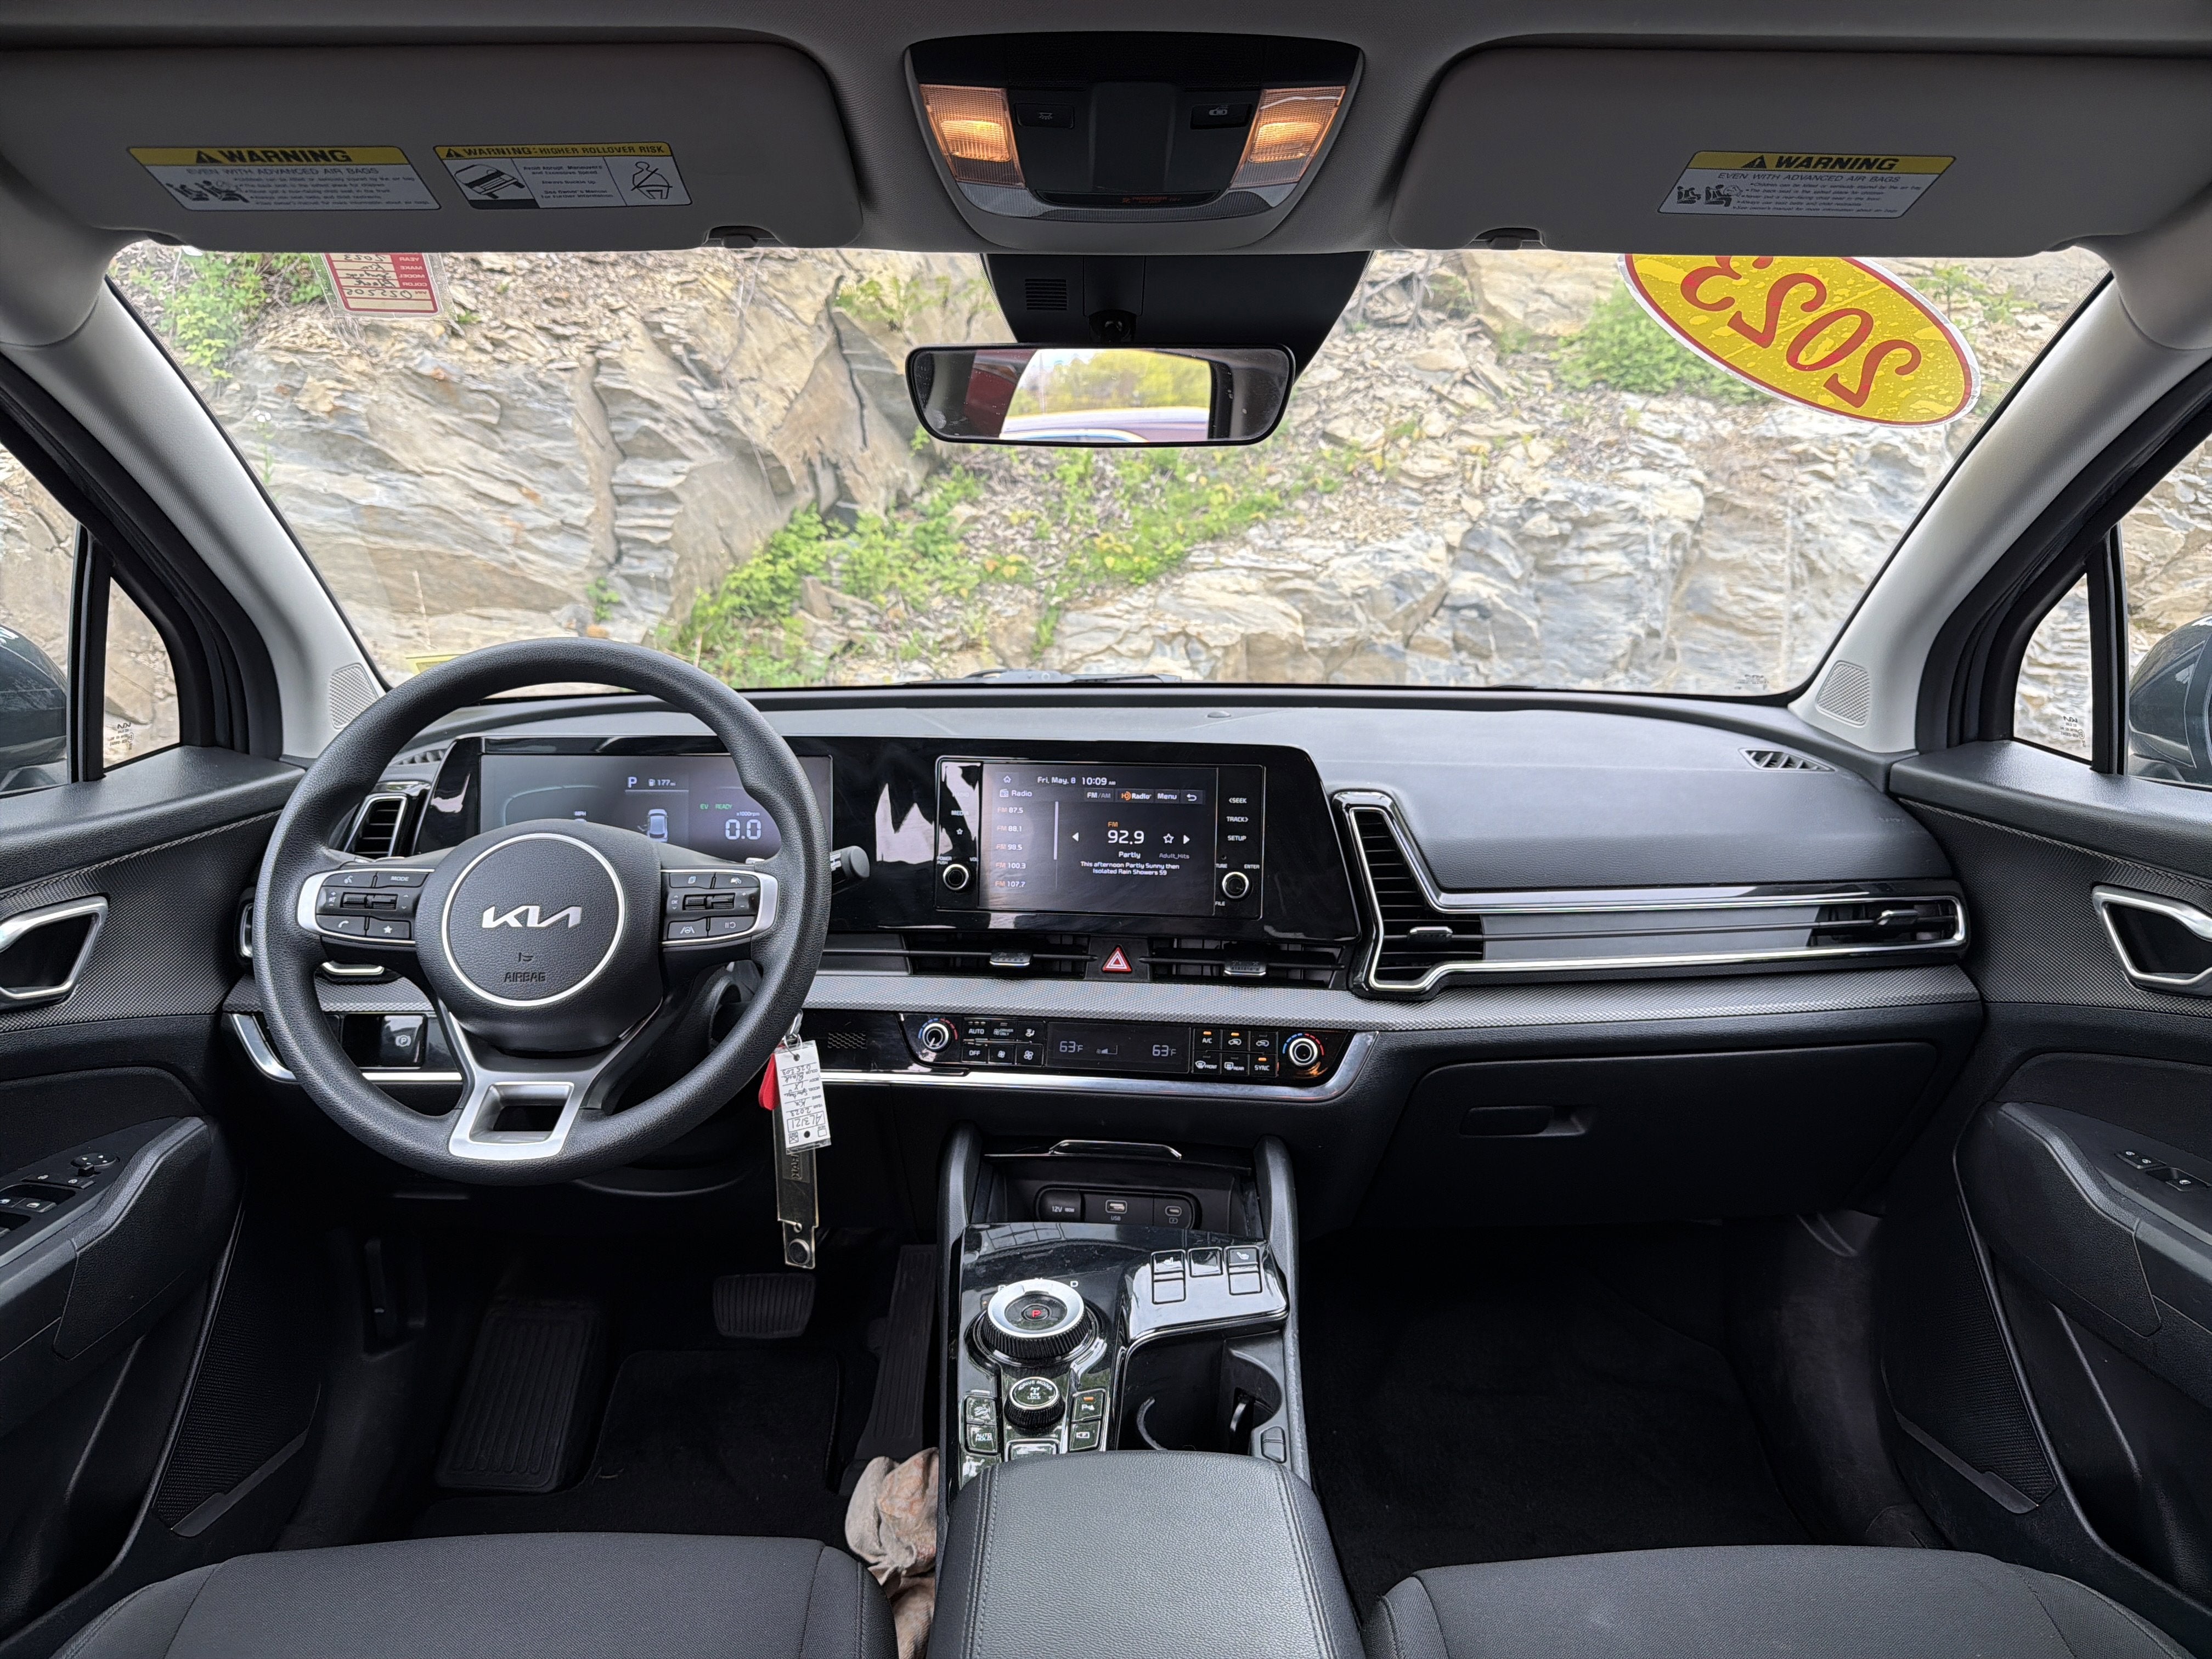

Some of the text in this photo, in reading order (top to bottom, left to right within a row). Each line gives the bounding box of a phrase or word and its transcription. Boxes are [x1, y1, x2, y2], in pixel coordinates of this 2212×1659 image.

[582, 146, 635, 154] ROLLOVER
[218, 150, 354, 163] WARNING
[1775, 155, 1900, 171] WARNING
[628, 776, 637, 788] P
[1082, 777, 1107, 786] 10:09
[725, 819, 761, 840] 0.0
[1108, 829, 1144, 845] 92.9
[1119, 851, 1141, 859] Partly
[482, 905, 582, 928] KIA
[504, 972, 546, 983] AIRBAG
[790, 1108, 811, 1117] 2023
[1031, 1310, 1042, 1318] P
[1019, 1380, 1052, 1390] DRIVE MODE
